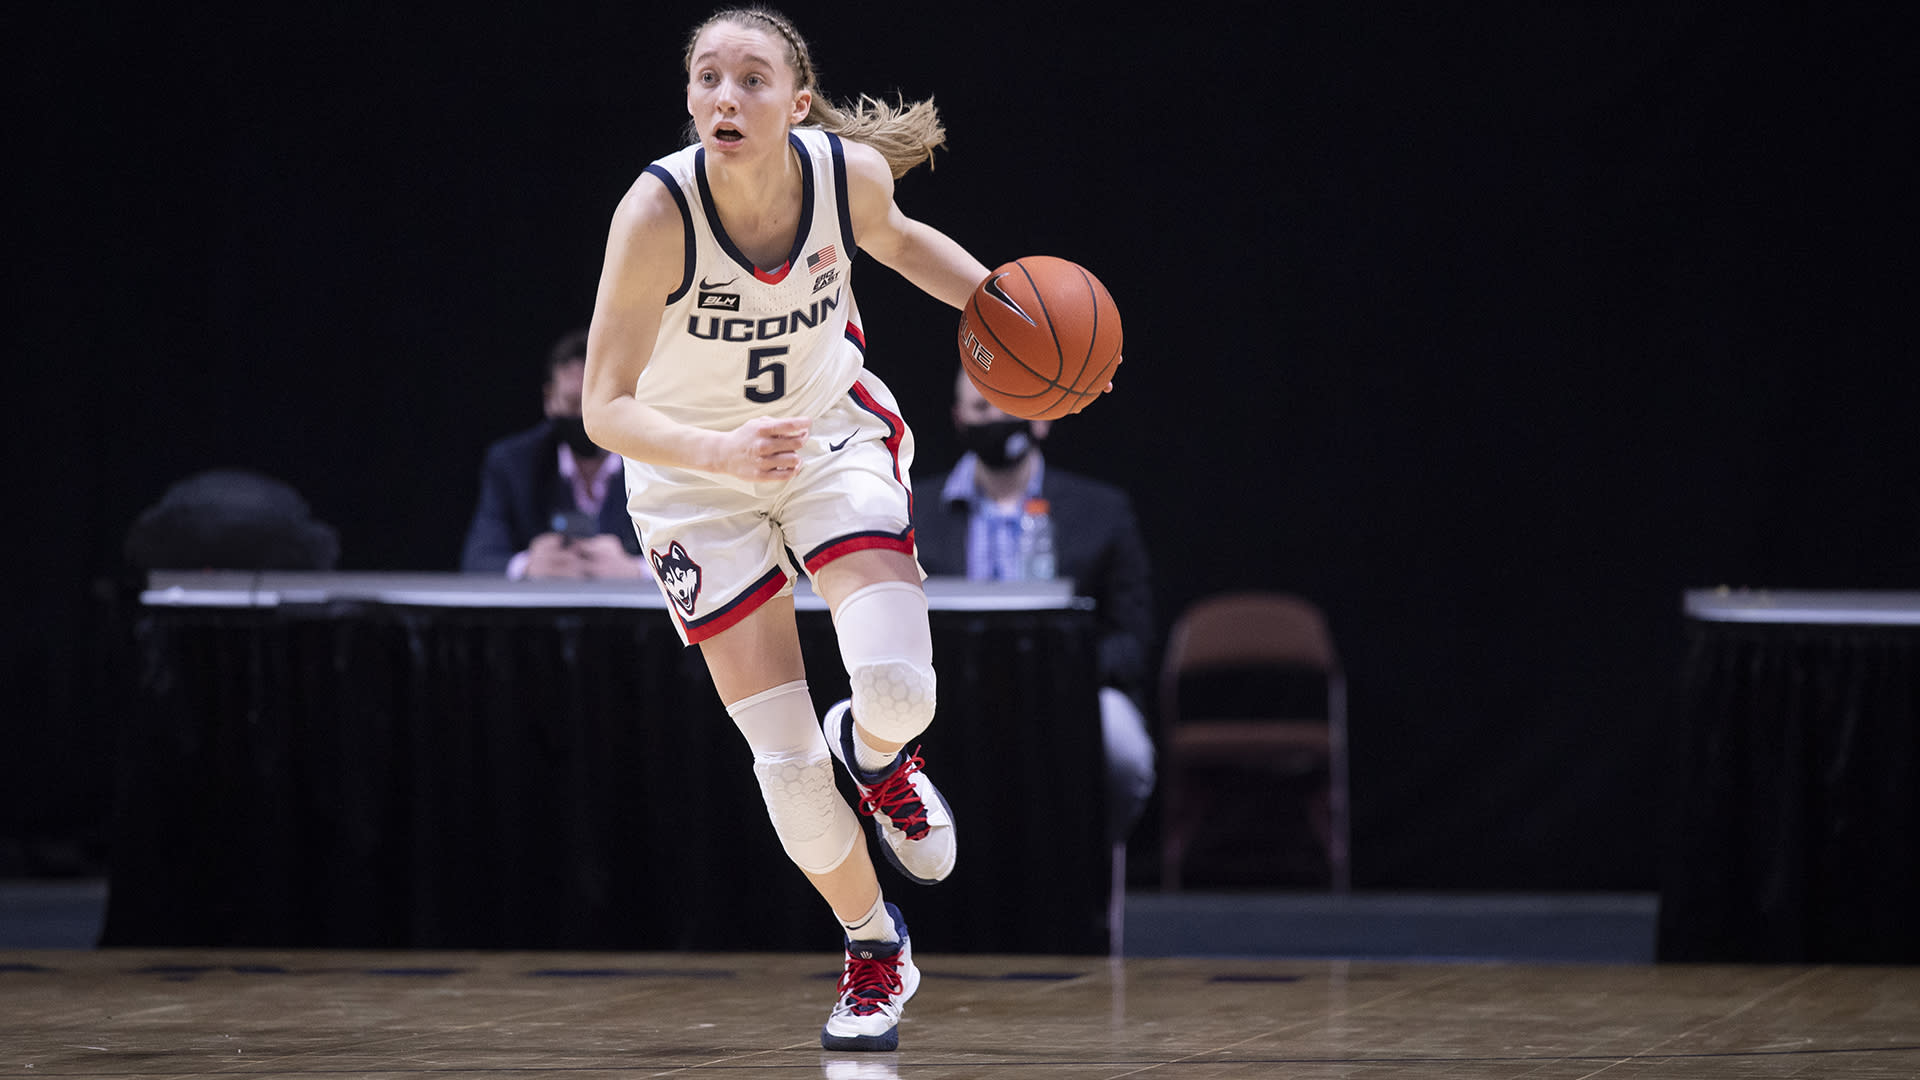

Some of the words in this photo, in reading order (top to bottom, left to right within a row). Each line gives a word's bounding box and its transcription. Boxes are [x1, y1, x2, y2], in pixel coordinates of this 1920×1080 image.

[704, 296, 737, 304] BLM
[812, 271, 840, 291] EAST
[688, 287, 841, 341] UCONN
[960, 312, 995, 371] LITE
[744, 344, 790, 404] 5
